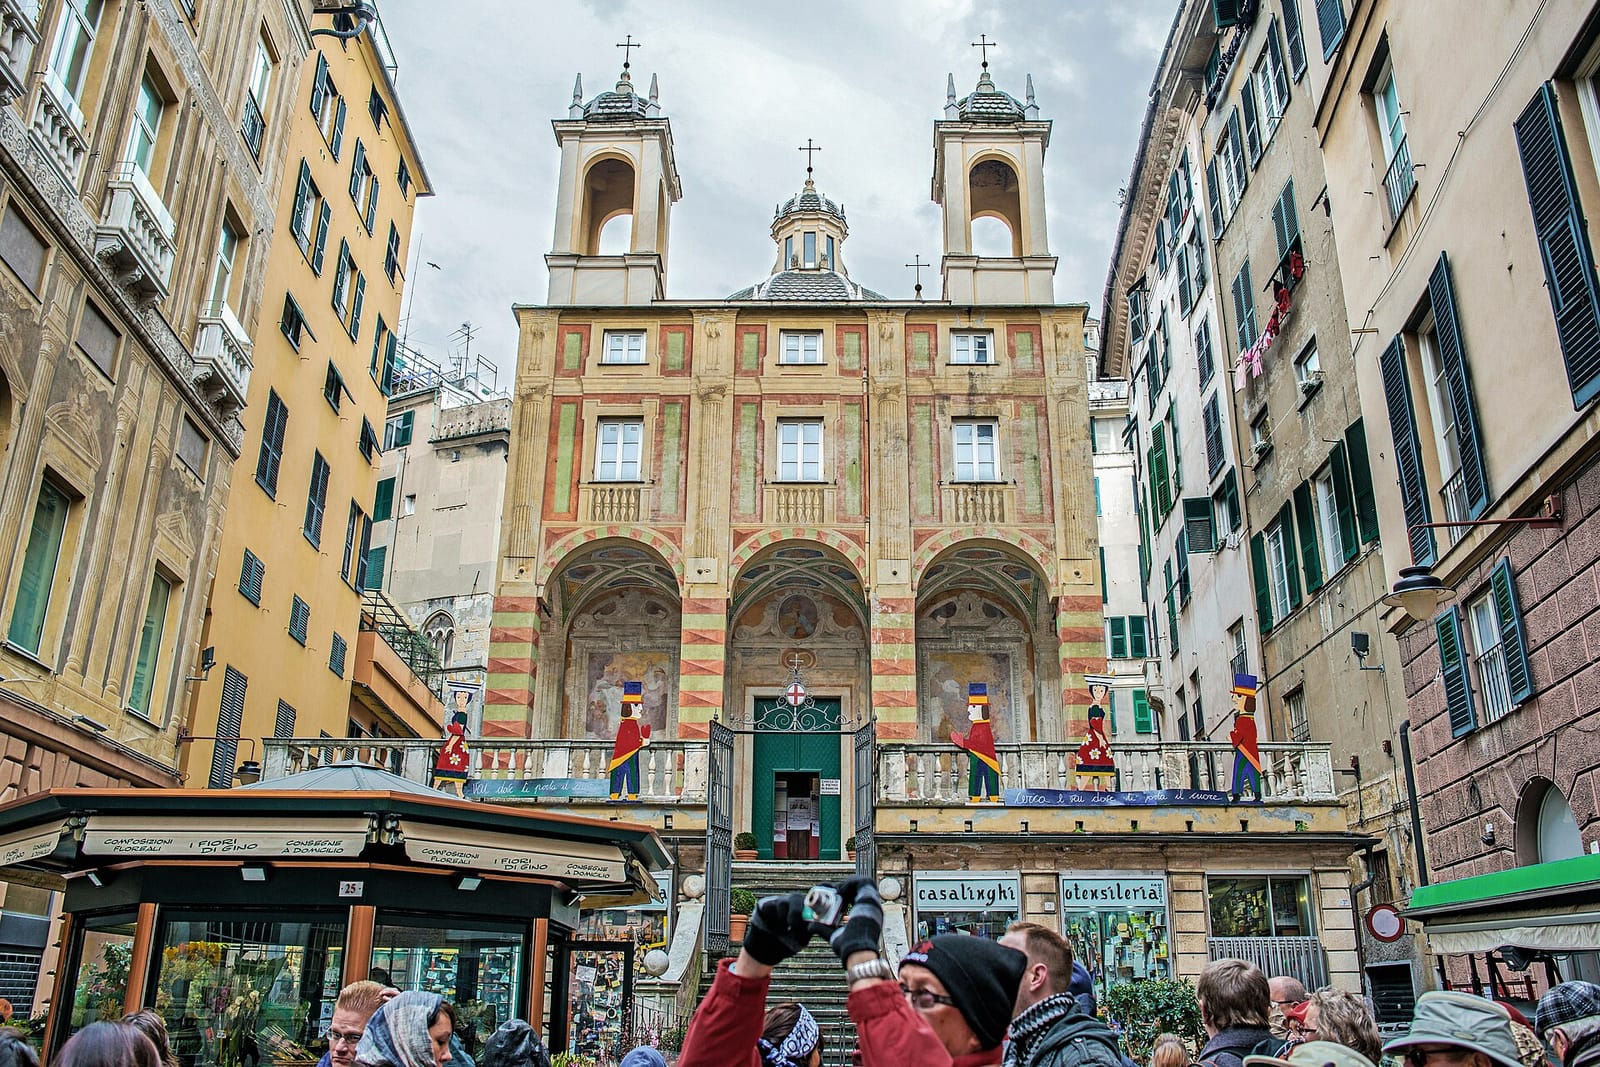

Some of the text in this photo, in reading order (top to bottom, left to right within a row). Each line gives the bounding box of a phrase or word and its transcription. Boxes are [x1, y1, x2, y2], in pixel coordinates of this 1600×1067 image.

[1175, 790, 1185, 800] il
[198, 838, 237, 848] FIORI
[221, 843, 258, 851] GINO
[286, 839, 343, 847] CONSEGNE
[421, 848, 480, 859] COMPOSIZIONI
[430, 855, 471, 865] FLOREALI
[501, 857, 532, 865] FIORI
[520, 863, 548, 871] GINO
[566, 863, 609, 872] CONSEGNE
[345, 883, 356, 894] 25
[1065, 882, 1159, 900] utensileria
[918, 882, 1016, 907] casalinghi
